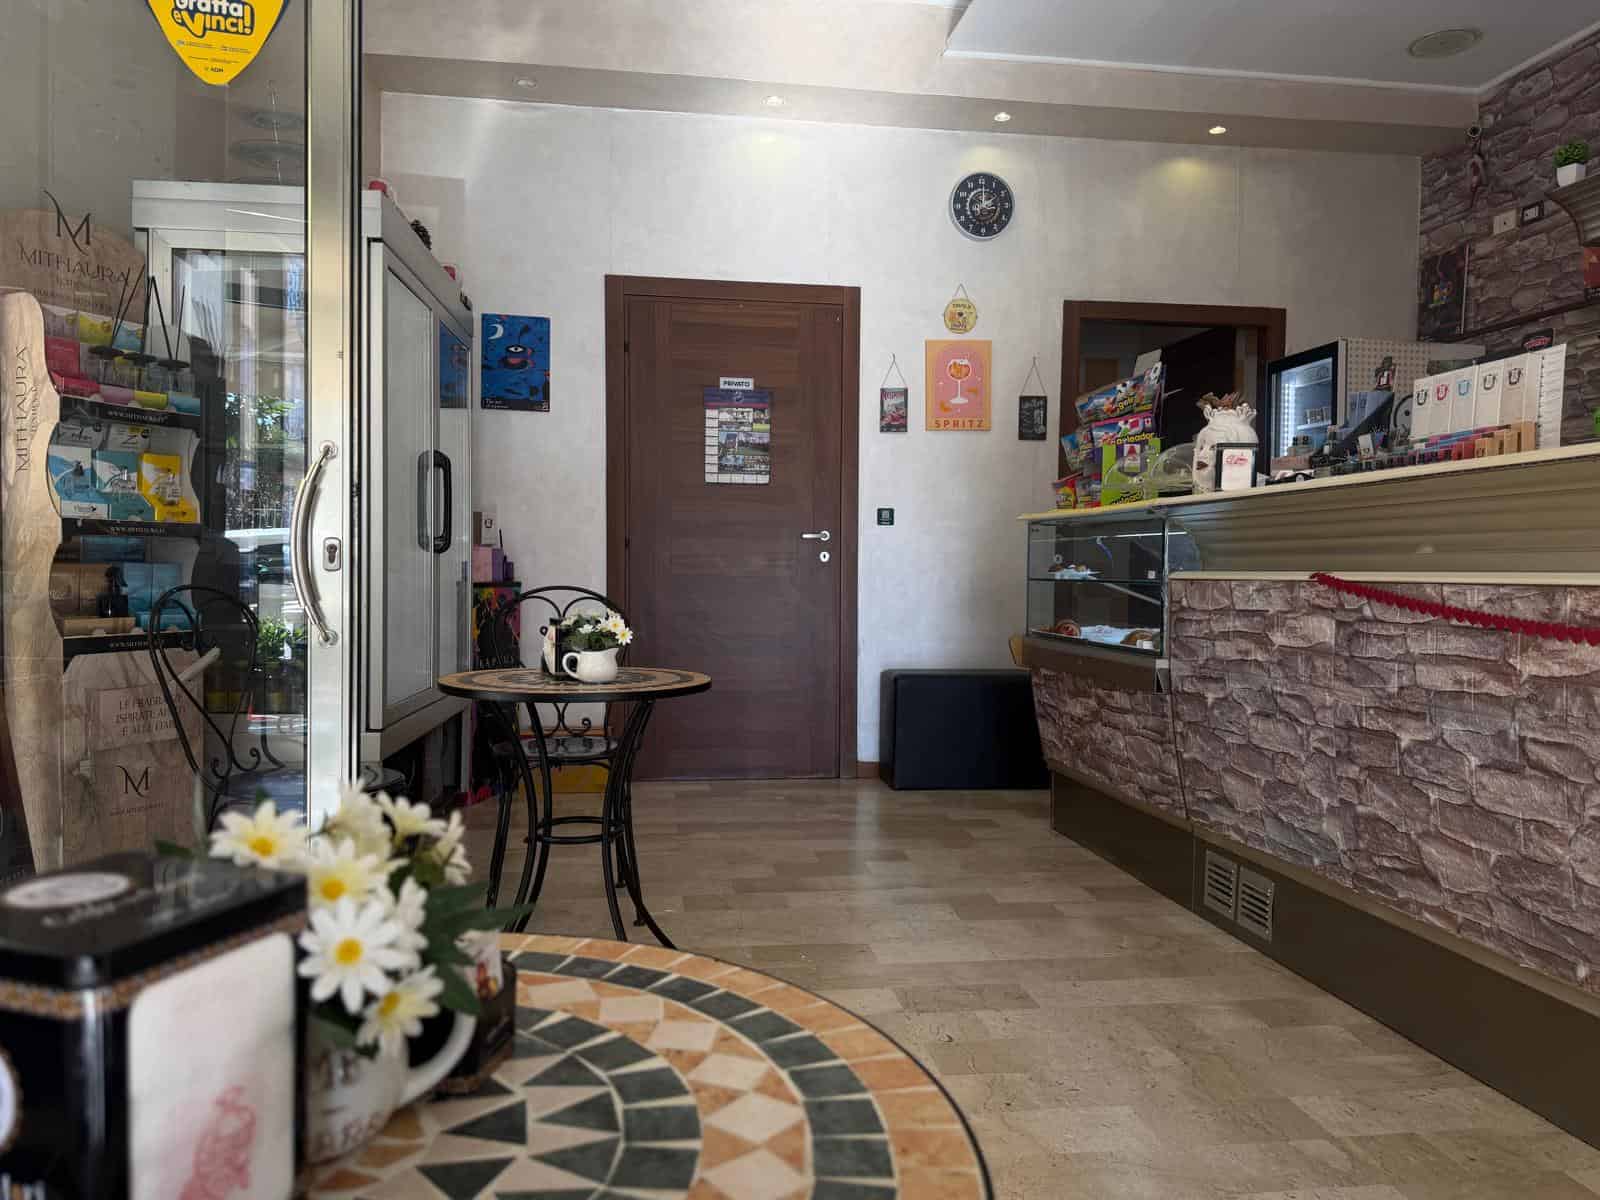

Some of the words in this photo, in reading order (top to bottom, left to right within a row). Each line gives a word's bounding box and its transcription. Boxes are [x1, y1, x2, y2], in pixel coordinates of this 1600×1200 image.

[722, 380, 751, 388] PRIVATO
[15, 344, 30, 472] MITHAURA
[935, 419, 984, 428] SPRITZ
